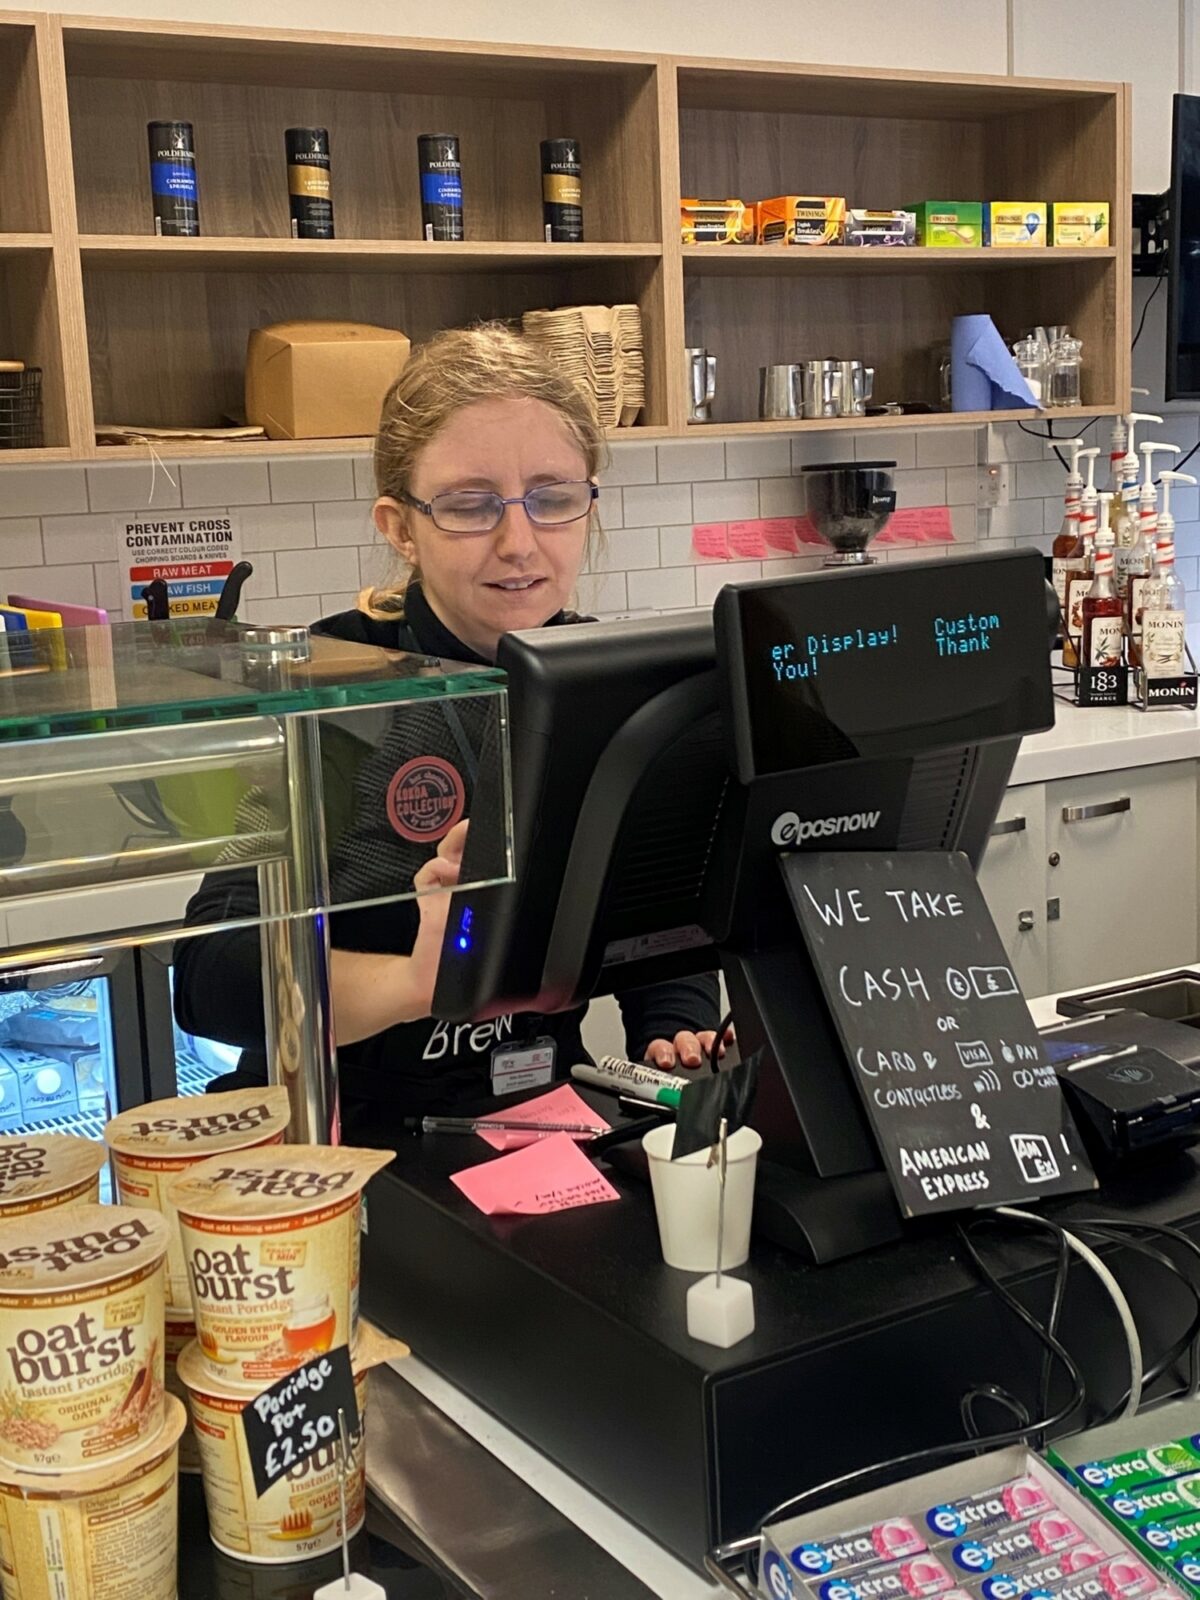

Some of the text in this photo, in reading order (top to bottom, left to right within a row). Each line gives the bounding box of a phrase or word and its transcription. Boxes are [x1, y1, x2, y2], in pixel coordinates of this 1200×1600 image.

[796, 209, 825, 219] TWININGS
[126, 519, 231, 535] PREVENT CROSS
[126, 531, 233, 548] CONTAMINATION
[135, 555, 169, 564] CHOPPING
[171, 553, 198, 562] BOARDS
[146, 547, 178, 556] CORRECT
[178, 545, 206, 554] COLOUR
[153, 564, 213, 578] RAW MEAT
[167, 582, 212, 595] AW FISH
[142, 603, 190, 615] CKED
[771, 613, 1000, 661] er Display! Custom
[1148, 620, 1184, 629] MONIN
[772, 632, 991, 681] You! Thank
[1148, 684, 1196, 698] MONIN
[771, 811, 881, 845] eposnow
[803, 884, 964, 926] WE TAKE
[839, 965, 931, 1007] CASH
[422, 1013, 513, 1060] Brew
[936, 1016, 960, 1032] OR
[856, 1047, 917, 1077] CARD
[962, 1048, 988, 1062] VISA
[1016, 1044, 1040, 1062] PAY
[131, 1103, 274, 1137] burst
[970, 1102, 991, 1130] &
[899, 1140, 991, 1177] AMERICAN
[209, 1167, 354, 1190] burst
[920, 1170, 990, 1201] EXPRESS
[216, 1223, 231, 1233] add
[232, 1222, 263, 1234] boiling
[264, 1221, 291, 1232] water
[193, 1242, 253, 1276] oat
[276, 1252, 297, 1262] MIN
[189, 1266, 295, 1301] burst
[32, 1297, 52, 1307] Just
[53, 1294, 74, 1304] add
[237, 1297, 294, 1317] Porridge
[119, 1311, 137, 1322] MIN
[211, 1322, 284, 1335] GOLDEN SYRUP
[16, 1311, 98, 1356] oat
[225, 1332, 269, 1343] FLAVOUR
[7, 1325, 136, 1385] burst
[20, 1358, 136, 1399] Instant Porridge
[253, 1358, 333, 1424] Porridge
[57, 1394, 113, 1416] ORIGINAL
[72, 1408, 102, 1422] OATS
[264, 1414, 336, 1479] £2.50
[290, 1469, 335, 1493] Instant
[1083, 1457, 1150, 1485] extra
[309, 1486, 340, 1507] GOLDE
[1113, 1489, 1180, 1516] extra
[934, 1498, 1005, 1532] extra
[800, 1536, 873, 1569] extra
[960, 1533, 1033, 1567] extra
[828, 1573, 903, 1600] extra
[990, 1566, 1063, 1599] extra
